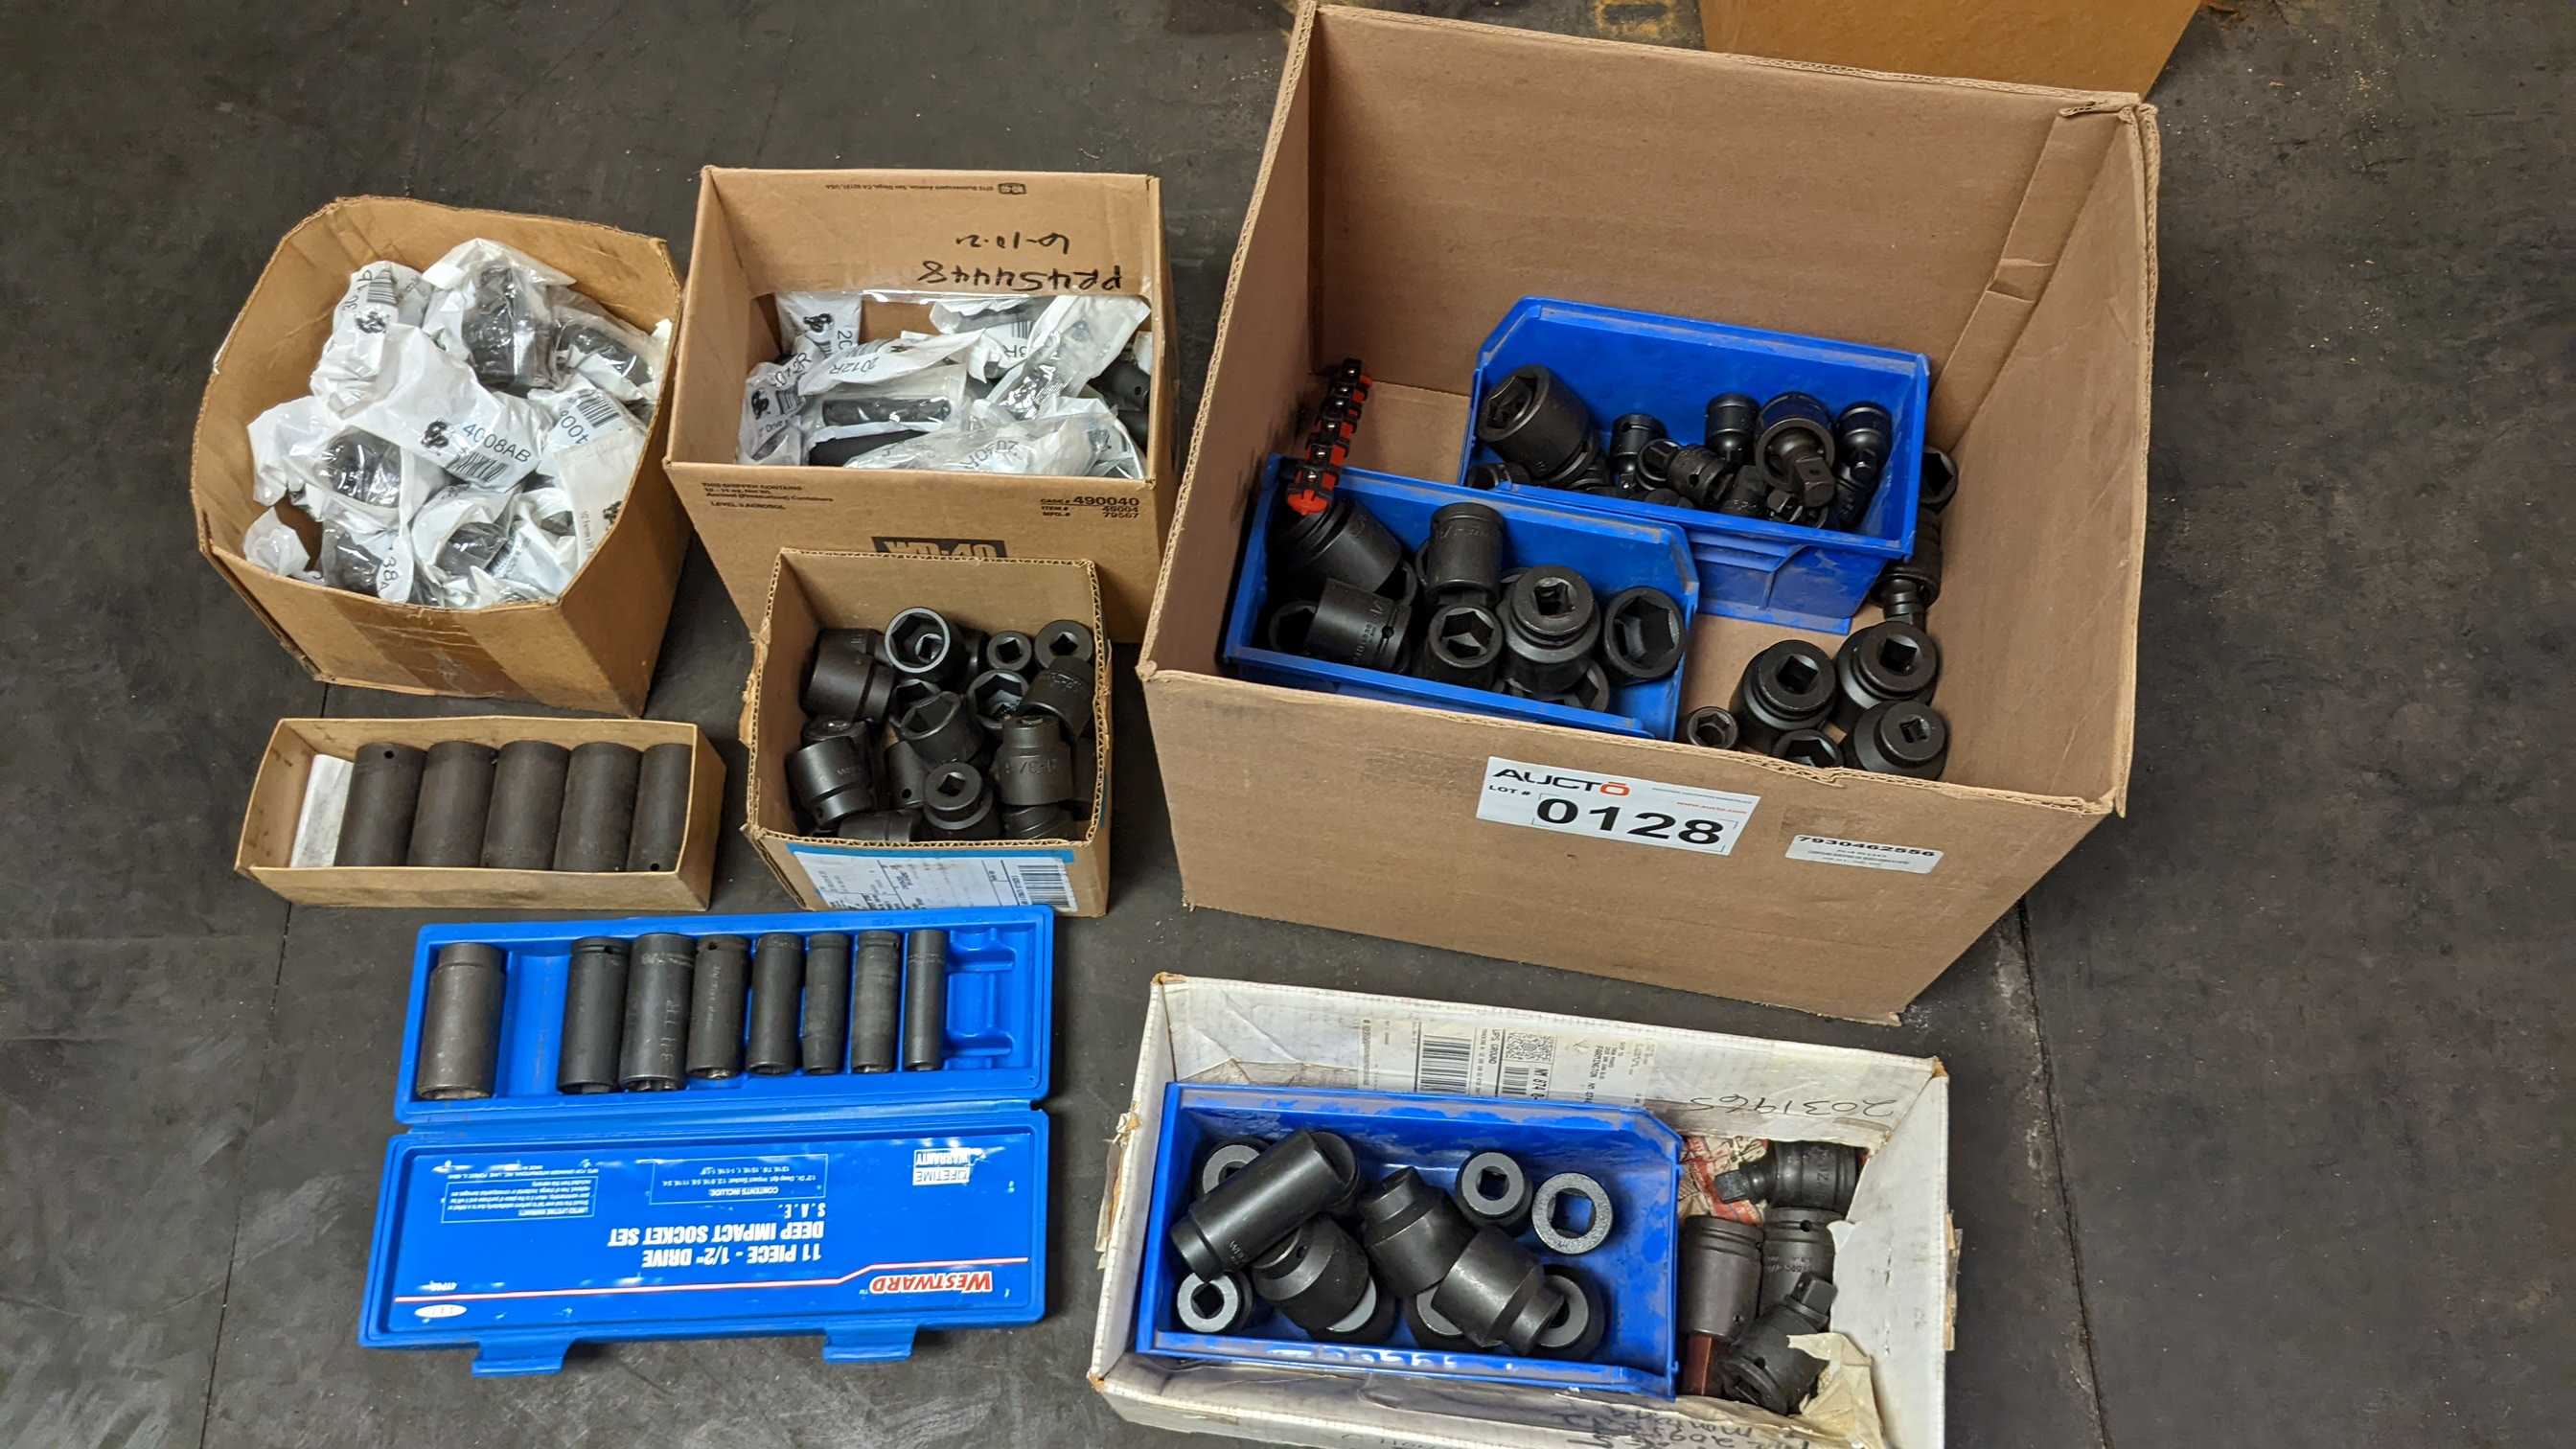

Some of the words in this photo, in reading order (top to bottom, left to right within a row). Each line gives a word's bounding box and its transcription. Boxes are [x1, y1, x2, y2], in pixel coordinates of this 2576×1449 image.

[462, 423, 532, 463] 4008AB
[1072, 495, 1139, 506] 490040
[1488, 784, 1518, 794] LOT
[1536, 797, 1724, 845] 0128
[1798, 836, 1936, 857] 7930462556
[915, 1169, 967, 1183] LIFETIME
[607, 1227, 640, 1247] SET
[642, 1225, 709, 1246] SOCKET
[711, 1223, 776, 1243] IMPACT
[780, 1221, 825, 1240] DEEP
[641, 1248, 692, 1269] DRIVE
[746, 1244, 797, 1264] PIECE
[801, 1242, 821, 1261] 11
